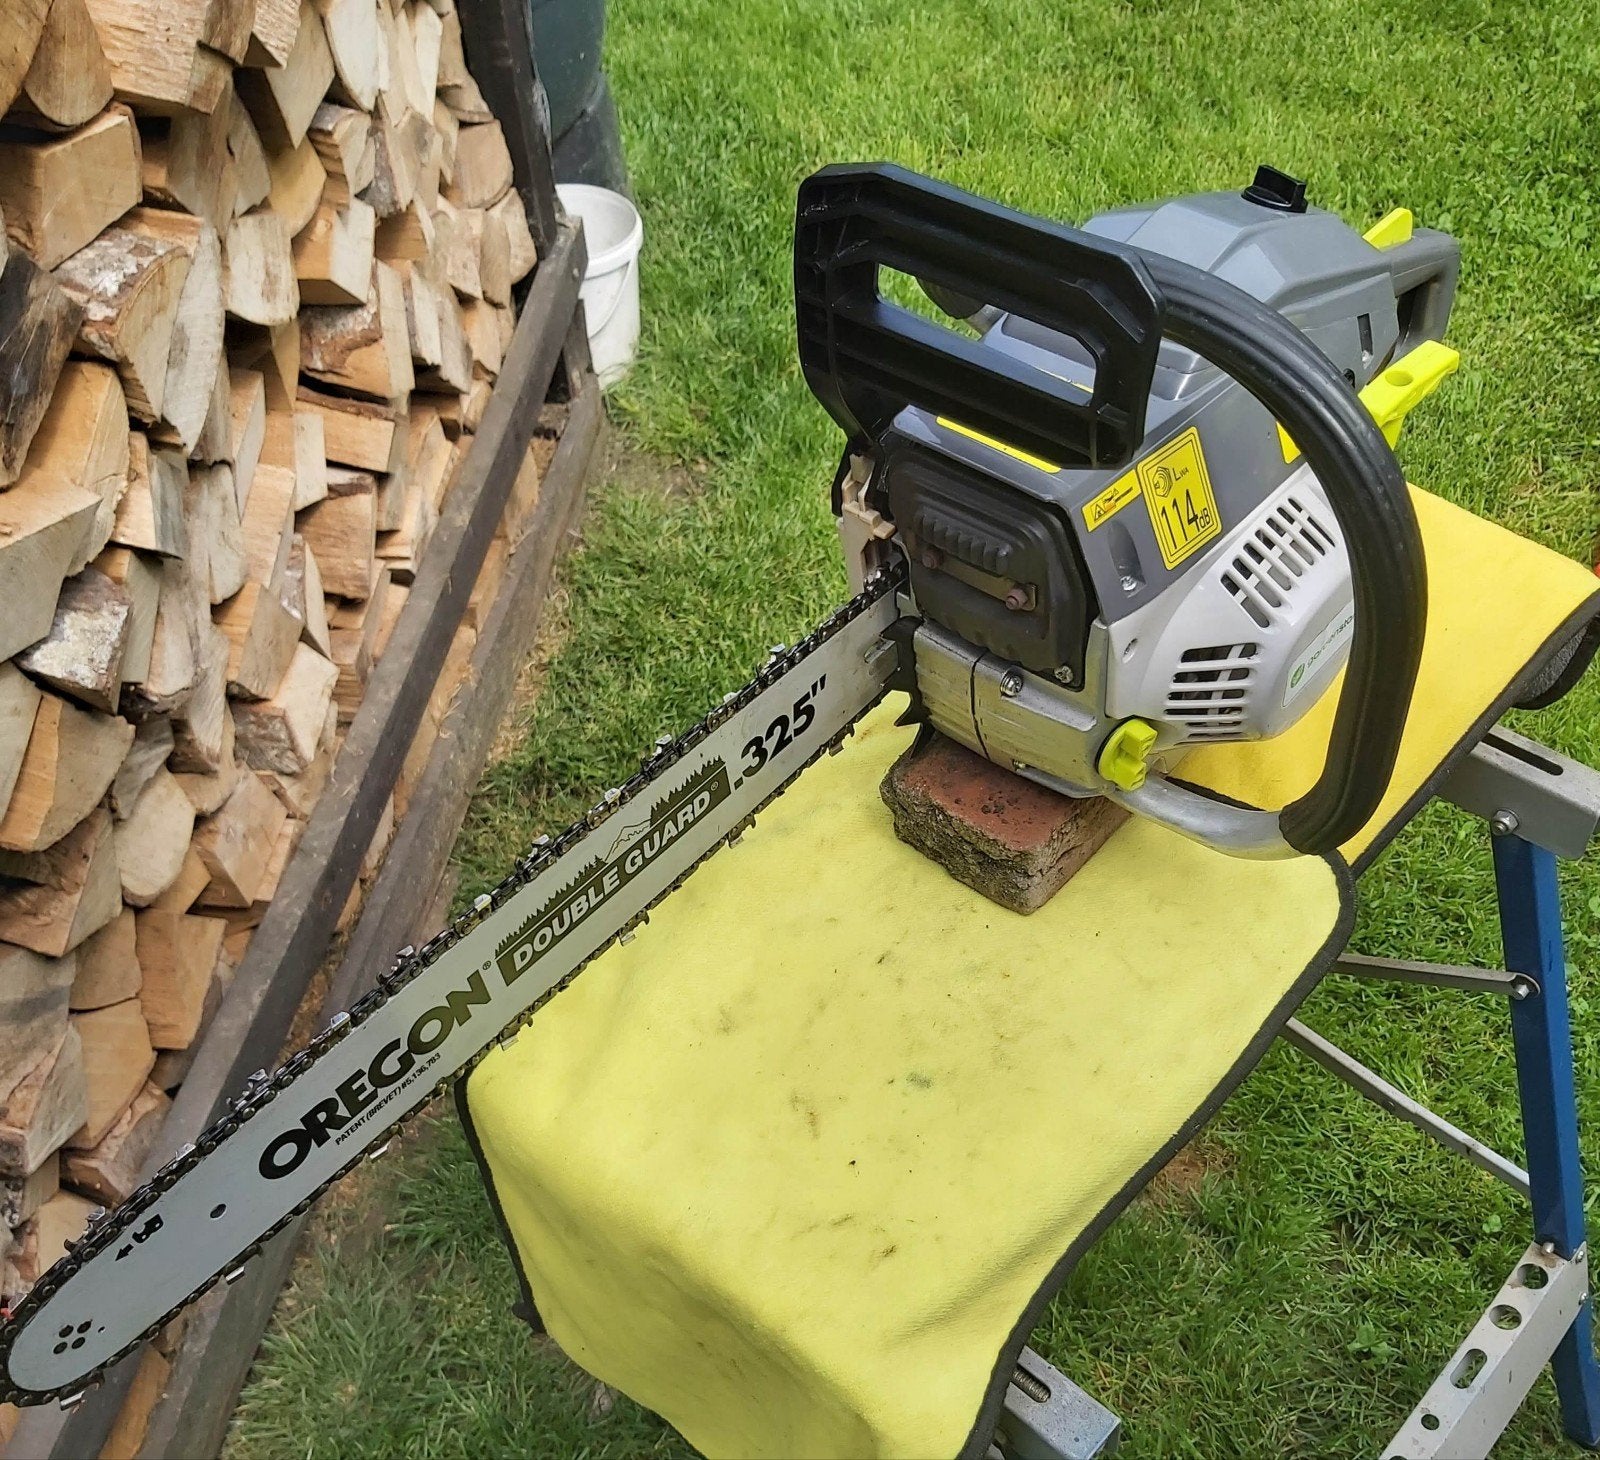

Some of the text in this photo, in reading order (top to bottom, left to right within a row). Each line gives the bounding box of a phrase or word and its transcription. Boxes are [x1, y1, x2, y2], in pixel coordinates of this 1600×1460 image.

[513, 791, 711, 972] DOUBLE GUARD
[335, 1114, 367, 1146] PATENT
[366, 1086, 402, 1122] (BREVET)
